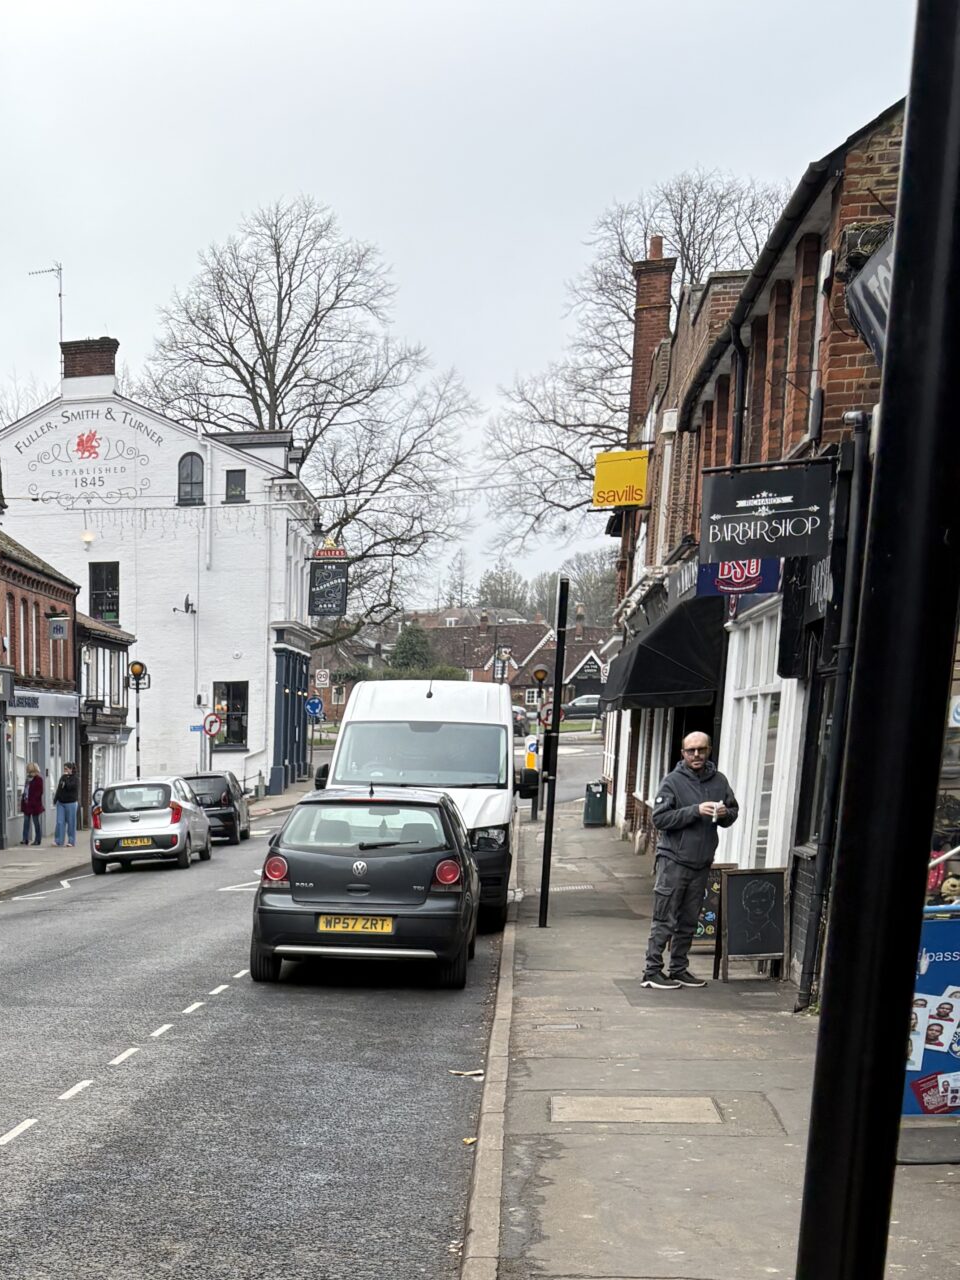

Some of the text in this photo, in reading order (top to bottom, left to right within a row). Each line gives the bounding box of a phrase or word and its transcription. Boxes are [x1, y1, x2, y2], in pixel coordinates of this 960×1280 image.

[13, 421, 58, 455] FULLER,
[104, 408, 117, 422] &
[122, 411, 164, 447] TURNER
[51, 466, 127, 477] ESTABLISHED
[74, 476, 105, 488] 1845
[596, 484, 644, 504] savills
[709, 516, 821, 545] BARBERSHOP
[325, 916, 388, 930] WP57 ZRT
